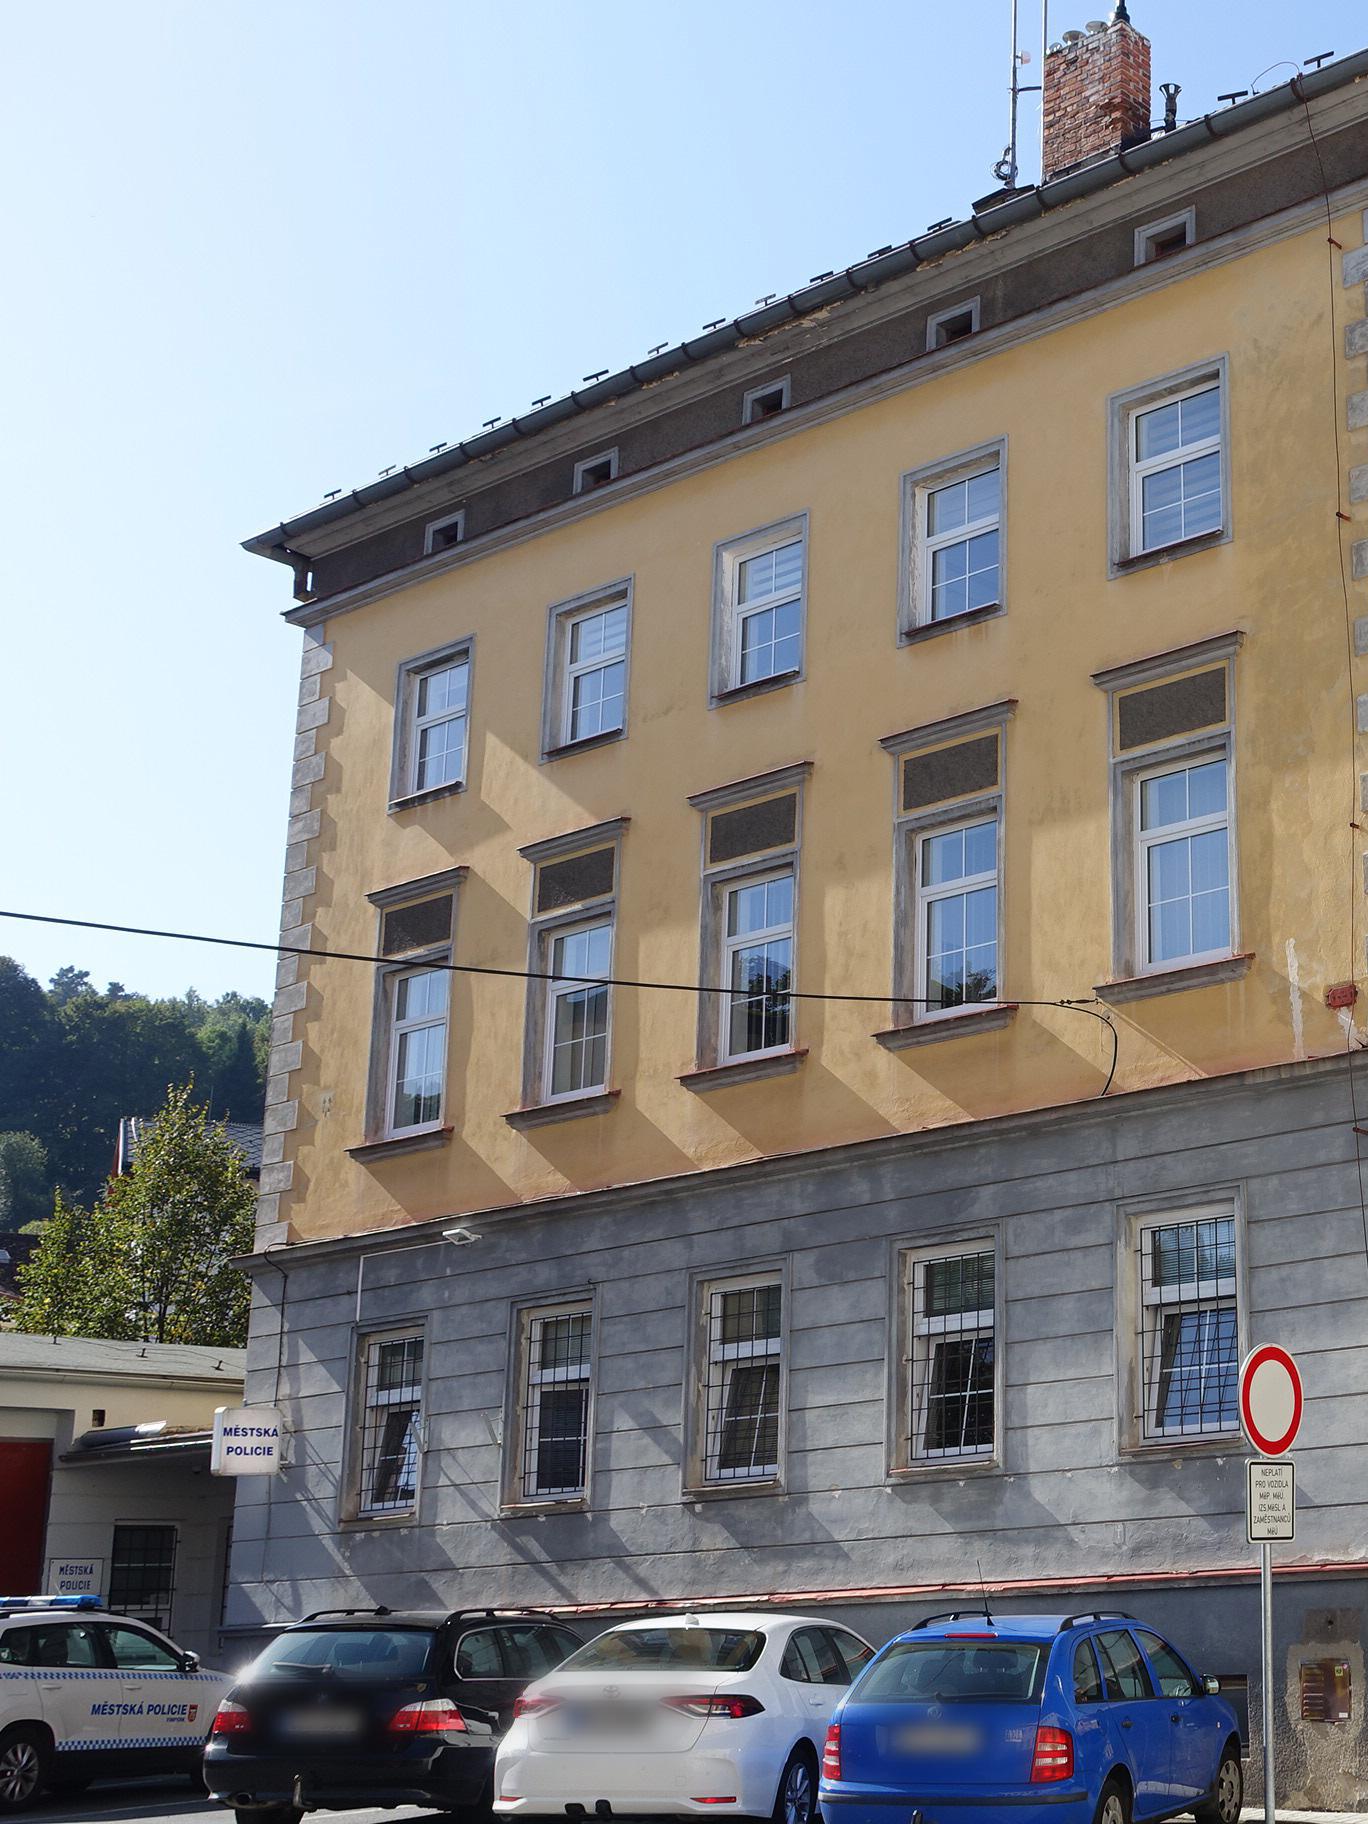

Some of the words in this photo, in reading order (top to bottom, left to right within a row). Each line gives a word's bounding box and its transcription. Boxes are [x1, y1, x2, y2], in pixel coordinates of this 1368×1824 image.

[223, 1424, 279, 1437] MĚSTSKÁ
[226, 1446, 274, 1456] POLICIE
[1255, 1480, 1266, 1488] PRO
[1267, 1480, 1289, 1488] VOZIDLA
[1282, 1503, 1287, 1512] A
[60, 1580, 92, 1590] POLICIE
[91, 1701, 144, 1715] MĚSTSKÁ
[146, 1704, 188, 1715] POLICIE
